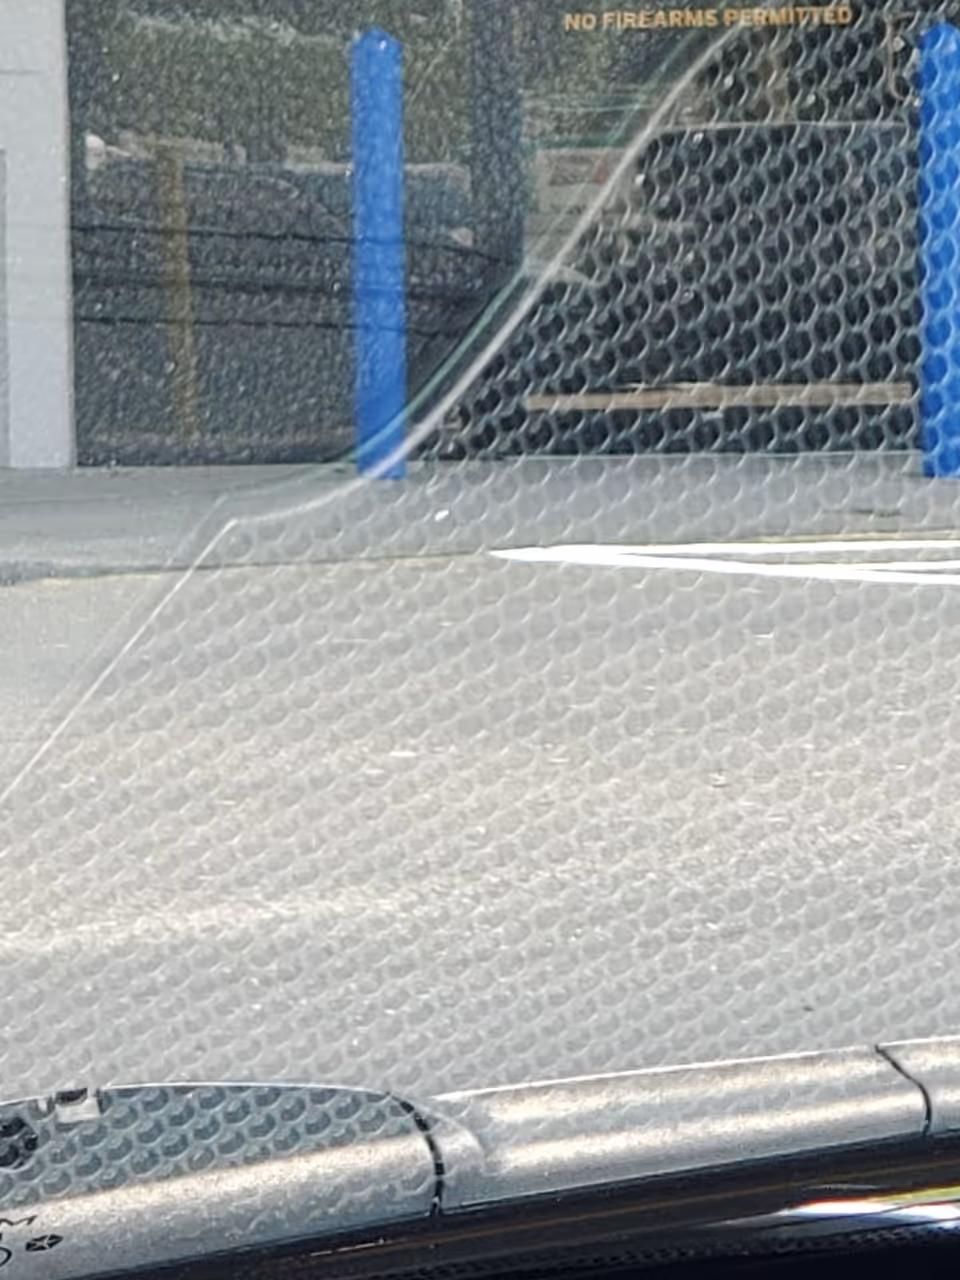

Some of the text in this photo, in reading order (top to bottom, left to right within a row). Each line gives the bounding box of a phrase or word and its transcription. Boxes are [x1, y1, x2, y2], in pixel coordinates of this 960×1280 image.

[564, 6, 853, 31] NO FIREARMS PERMITTED
